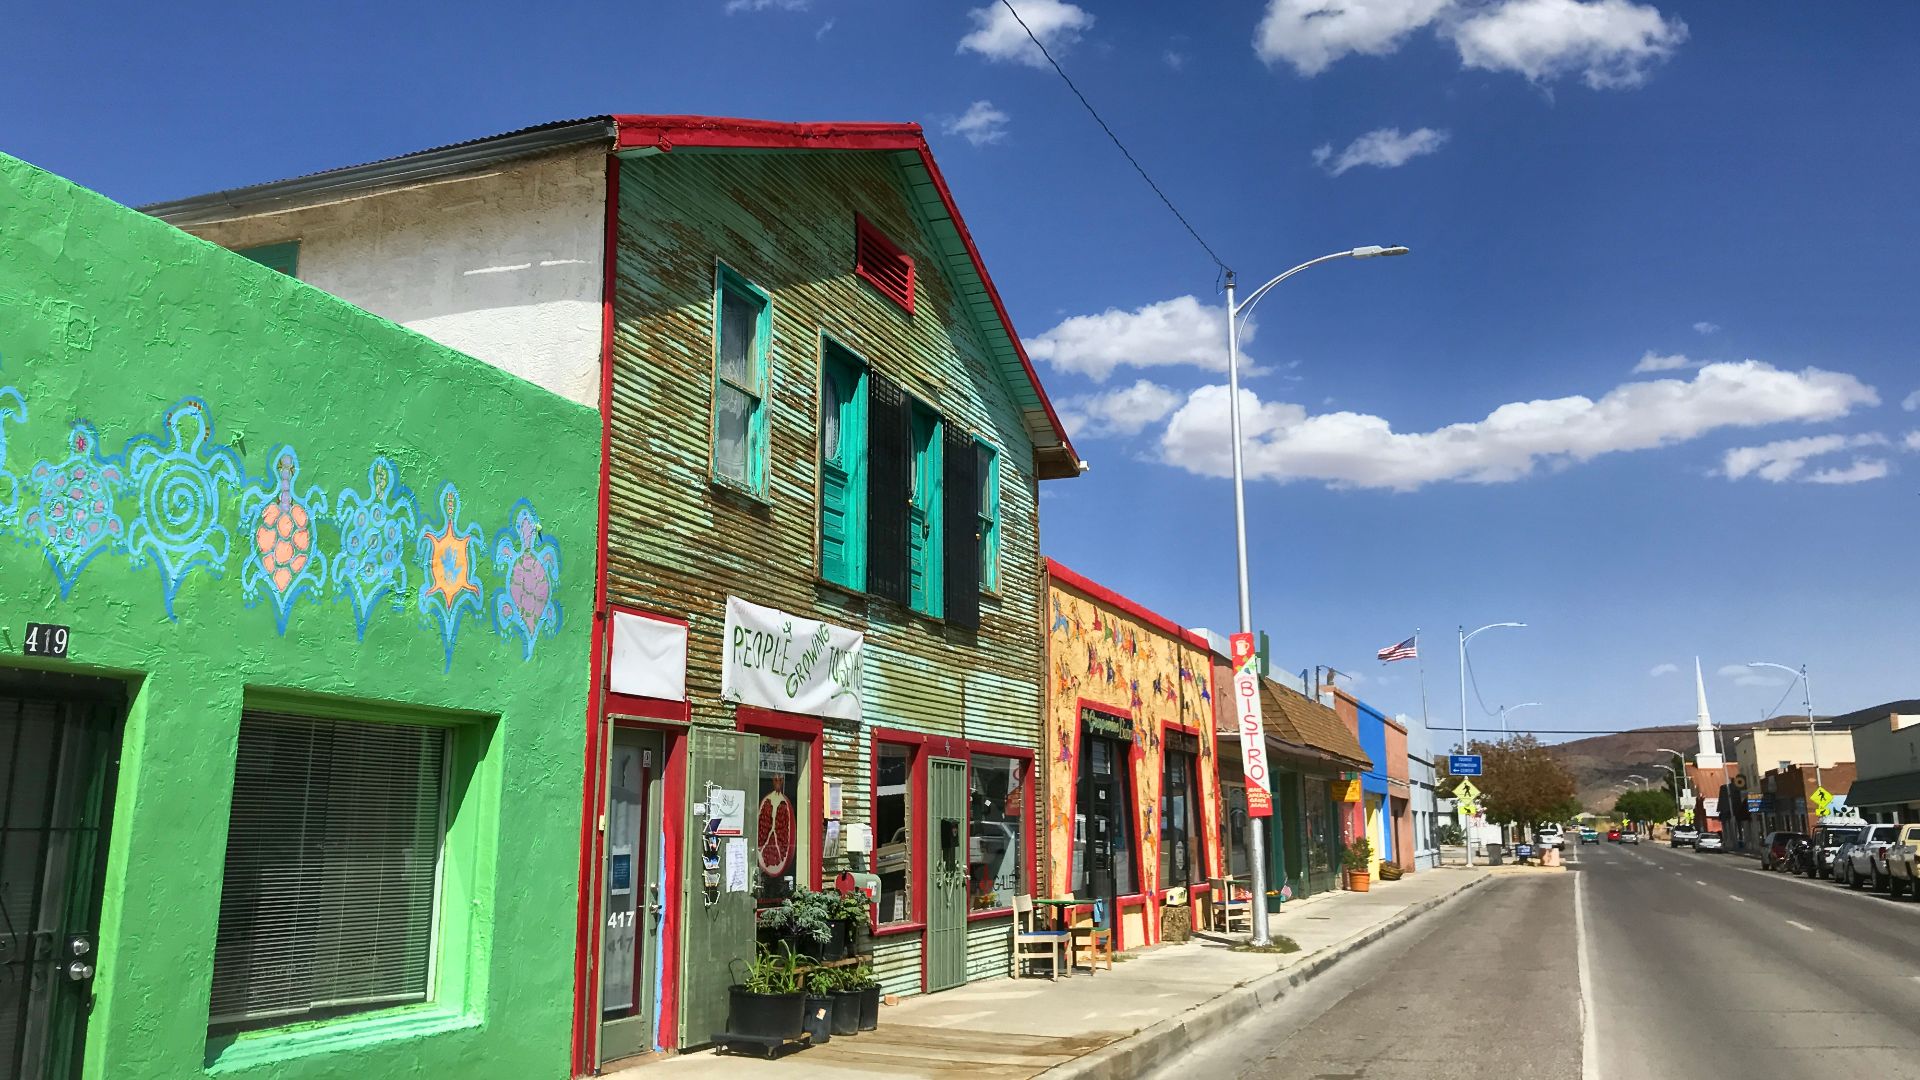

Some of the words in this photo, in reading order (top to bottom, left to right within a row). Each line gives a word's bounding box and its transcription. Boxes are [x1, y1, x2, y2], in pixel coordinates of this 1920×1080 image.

[25, 626, 68, 654] 419
[733, 625, 792, 677] PEOPLE
[785, 623, 830, 699] GROWING
[1240, 681, 1265, 781] BISTRO
[607, 910, 635, 929] 417
